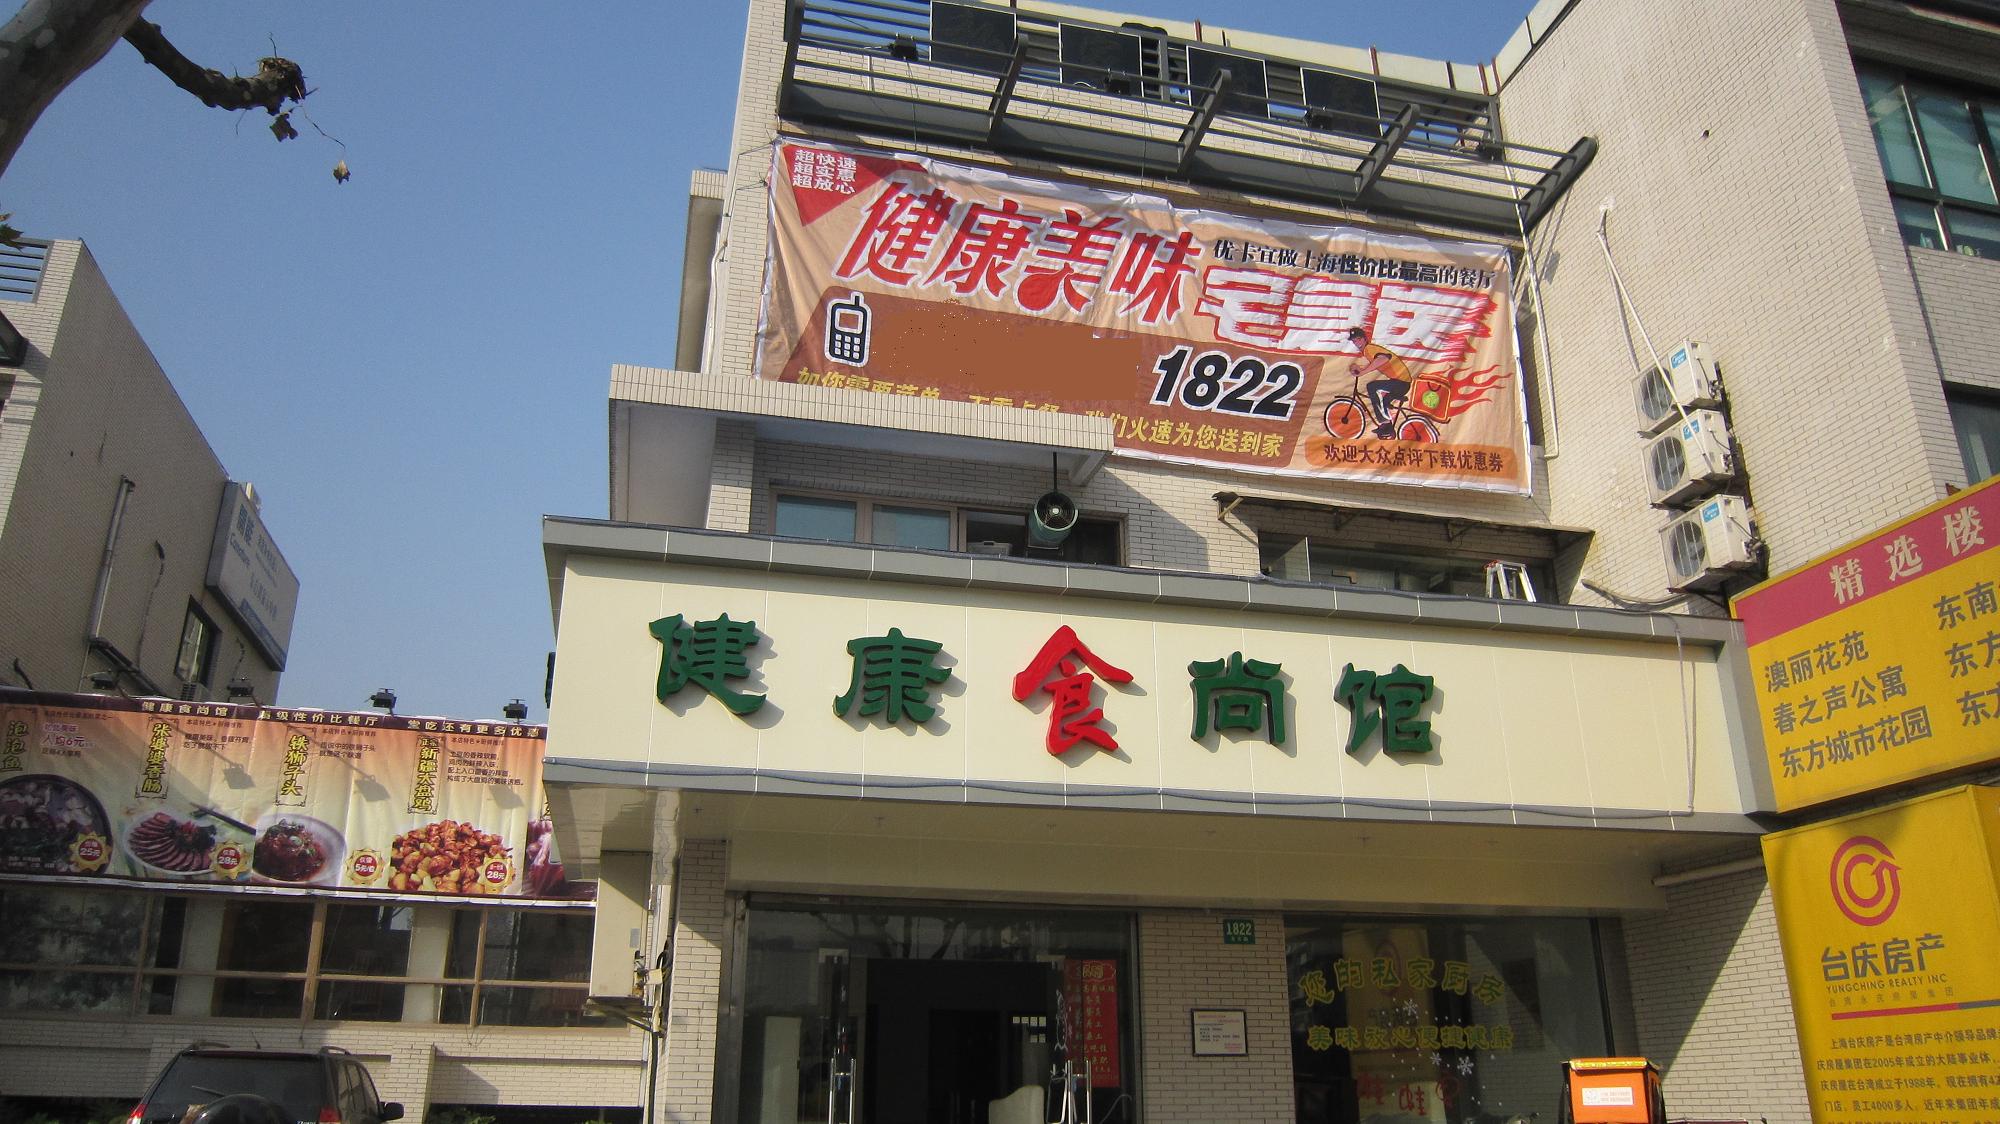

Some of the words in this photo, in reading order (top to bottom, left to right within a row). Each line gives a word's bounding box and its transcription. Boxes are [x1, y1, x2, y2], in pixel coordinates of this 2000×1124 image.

[792, 174, 856, 195] 超放心
[793, 161, 856, 182] 超实惠
[795, 149, 858, 170] 超快速
[834, 180, 1203, 325] 健康美味
[1213, 239, 1497, 290] 优卡宜做上海性价比最高的餐厅
[1152, 346, 1304, 420] 1822
[1324, 443, 1503, 473] 欢迎大众点评下载优惠券
[1829, 505, 1986, 605] 精选楼
[1933, 579, 2000, 631] 东南
[649, 611, 1435, 757] 健康食尚馆
[1764, 630, 1870, 694] 澳丽花苑
[141, 701, 229, 717] 健康食尚馆
[1773, 664, 1908, 736] 春之声公寓
[1, 719, 29, 773] 泡泡鱼
[407, 719, 540, 738] 堂吃还有更多优惠
[1779, 704, 1933, 779] 东方城市花园
[141, 723, 172, 793] 张婆婆香肠
[281, 735, 309, 796] 铁狮子头
[413, 748, 438, 811] 新疆大盘鸡
[218, 857, 237, 866] 28元
[487, 871, 505, 880] 28元
[1226, 922, 1252, 936] 1822
[1298, 957, 1505, 1008] 您的私家厨房
[1821, 933, 1945, 982] 台庆房产
[1827, 979, 1885, 993] YUNGCHING
[1889, 975, 1924, 988] REALTY
[1927, 973, 1949, 984] INC
[1307, 1024, 1514, 1052] 美味放心便捷健康
